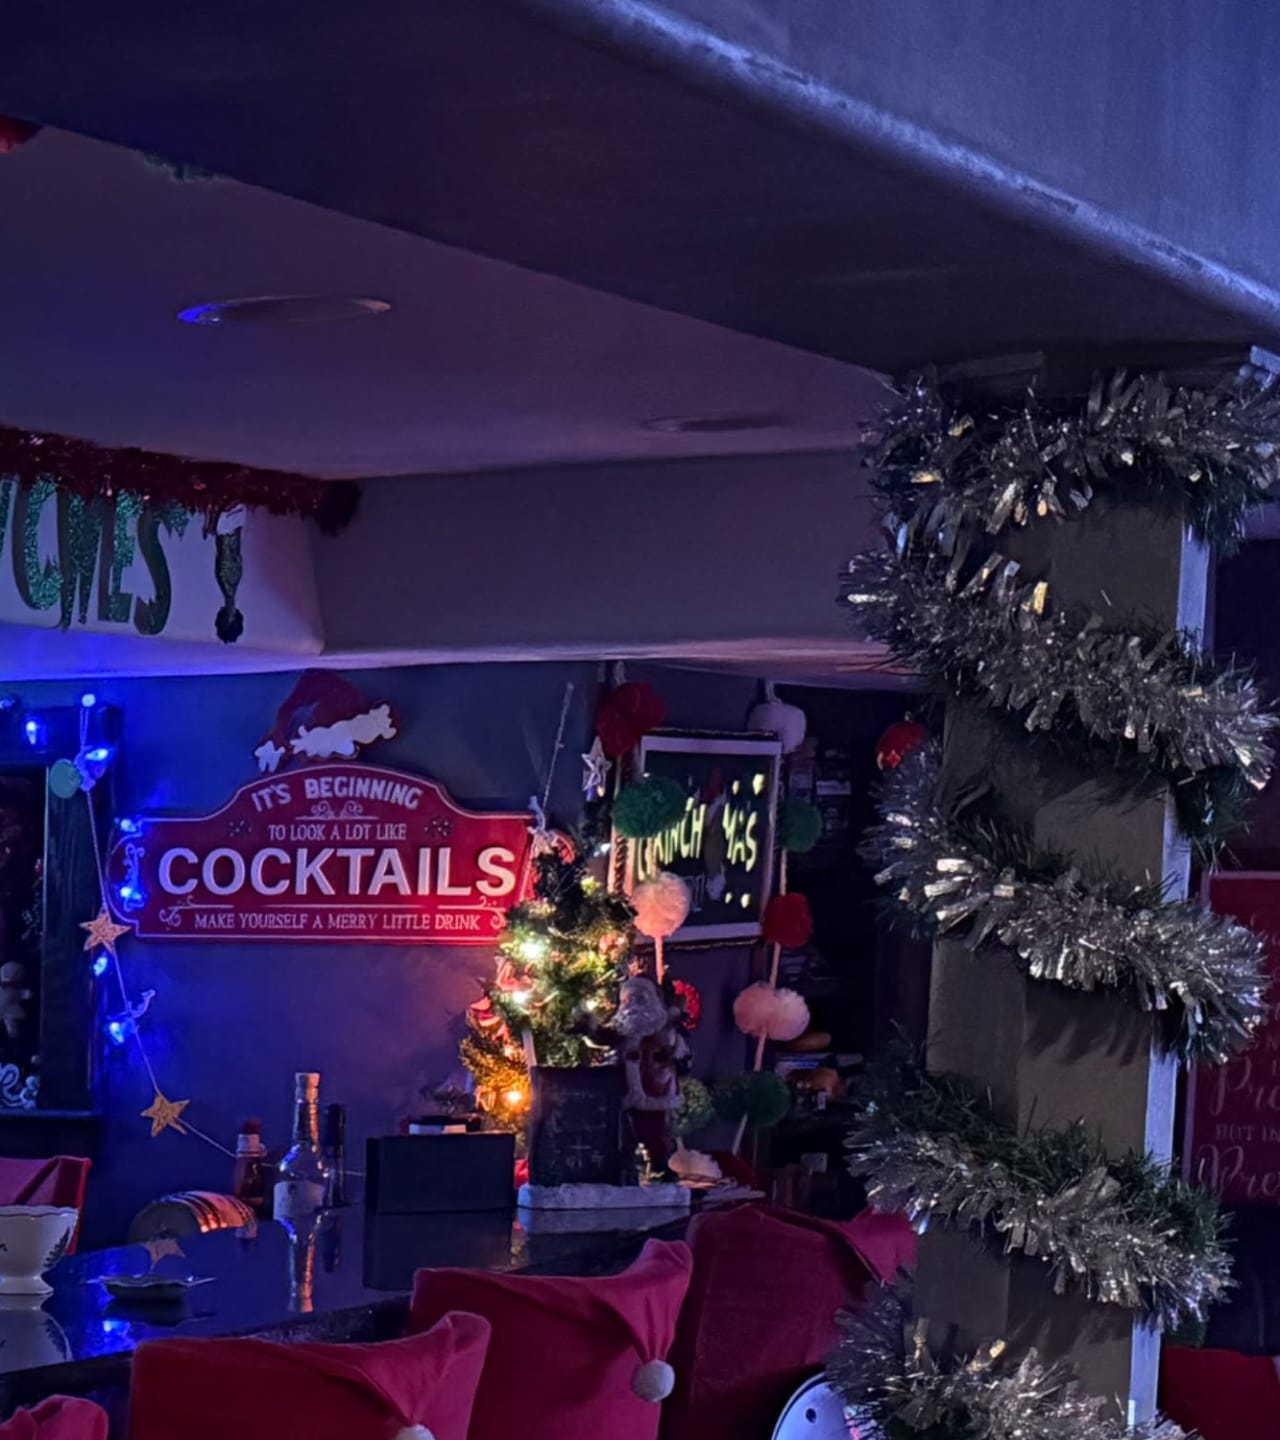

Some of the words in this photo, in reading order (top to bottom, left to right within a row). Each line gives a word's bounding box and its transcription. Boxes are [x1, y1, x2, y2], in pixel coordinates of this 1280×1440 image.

[250, 782, 292, 813] IT'S
[304, 775, 423, 811] BEGINNING
[267, 823, 286, 841] TO
[290, 822, 325, 841] LOOK
[329, 823, 340, 841] A
[345, 822, 373, 841] LOT
[376, 822, 407, 841] LIKE
[156, 846, 517, 897] COCKTAILS
[193, 913, 237, 929] MAKE
[239, 912, 309, 929] YOURSELF
[312, 913, 324, 929] A
[327, 912, 379, 930] MERRY
[382, 912, 432, 931] LITTLE
[433, 913, 481, 931] DRINK
